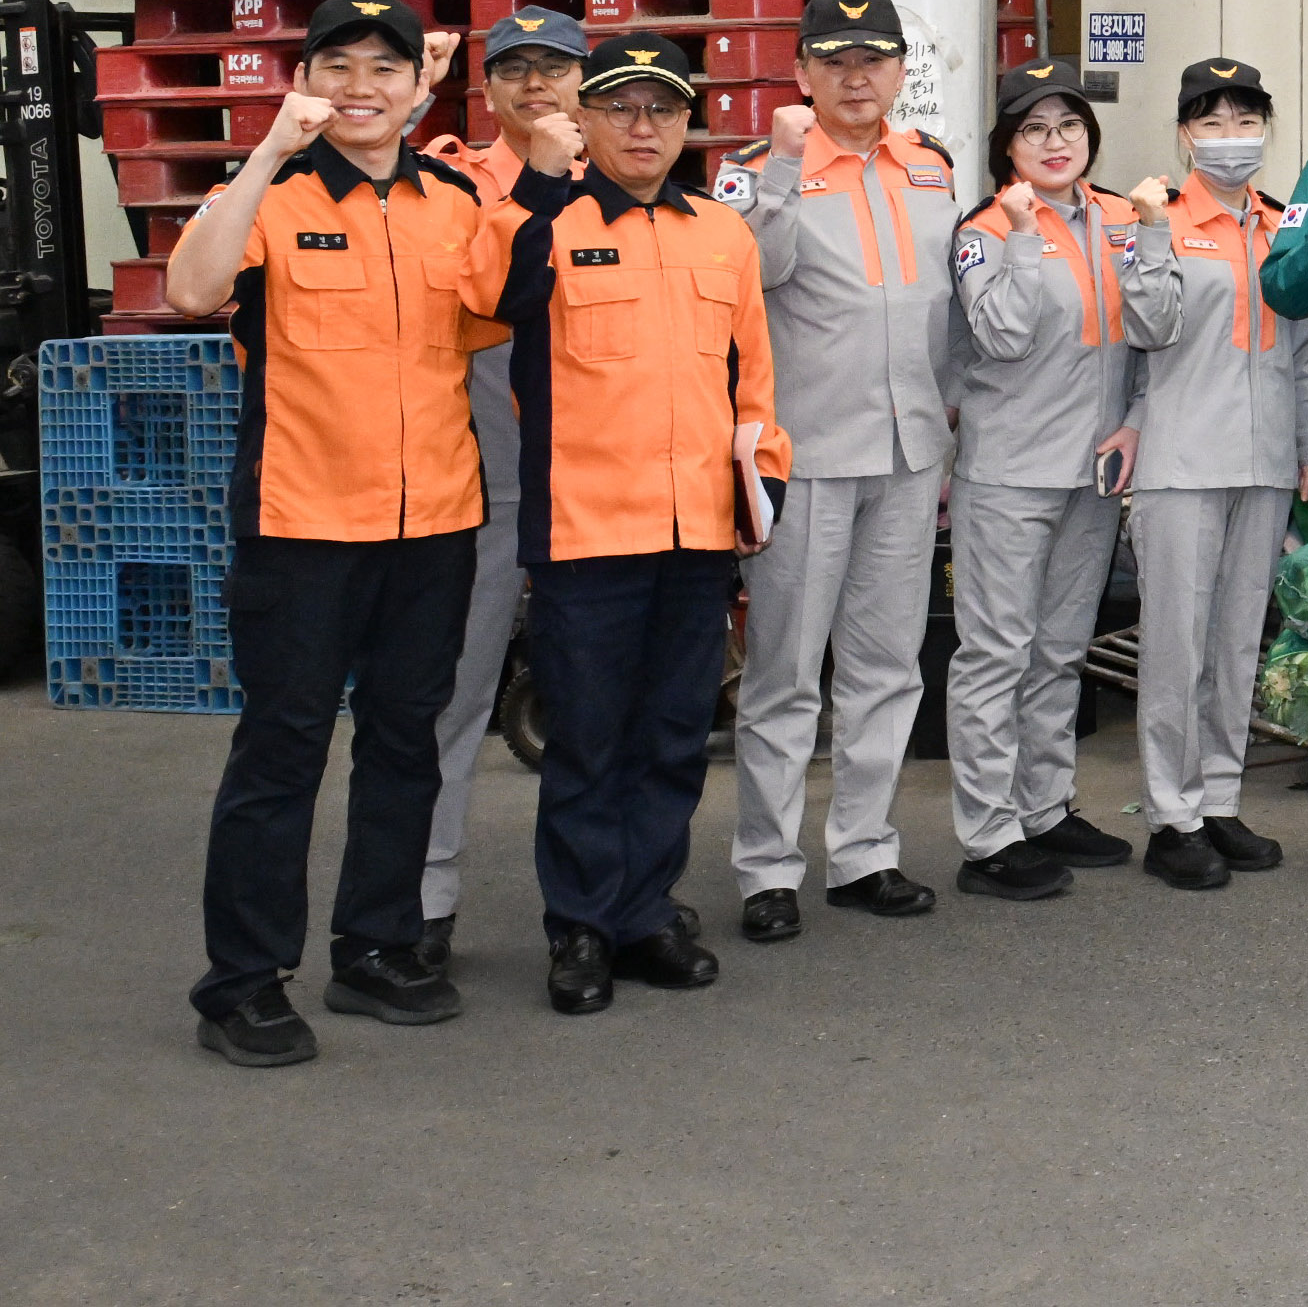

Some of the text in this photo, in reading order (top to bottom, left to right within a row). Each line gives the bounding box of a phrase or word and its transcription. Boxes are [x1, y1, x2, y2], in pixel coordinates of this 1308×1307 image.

[1091, 15, 1144, 36] 태양지게차
[1090, 40, 1143, 61] 010-9898-9115
[27, 86, 42, 102] 19
[20, 103, 51, 121] N066
[30, 137, 54, 259] TOYOTA
